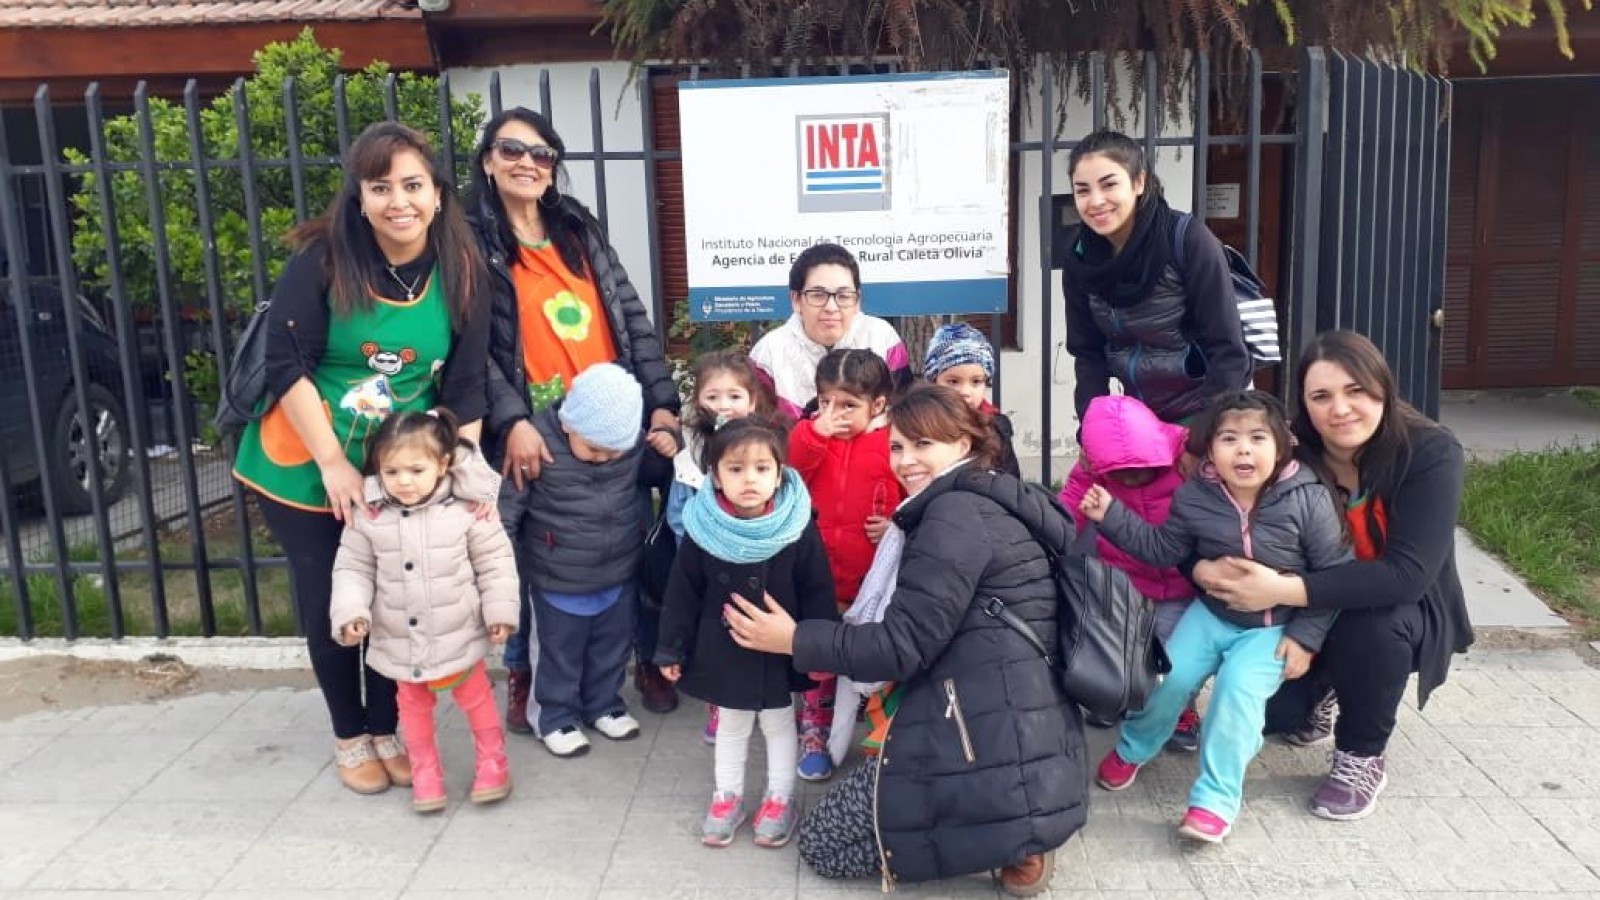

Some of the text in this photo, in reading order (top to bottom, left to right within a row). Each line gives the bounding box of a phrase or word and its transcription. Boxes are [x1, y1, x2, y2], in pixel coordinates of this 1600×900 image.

[805, 122, 880, 169] INTA
[701, 237, 754, 250] Instituto
[757, 235, 812, 249] Nacional
[815, 235, 832, 245] de
[906, 230, 993, 246] Agropecuaria
[711, 254, 765, 269] Agencia
[768, 252, 785, 265] de
[858, 248, 894, 263] Rural
[897, 247, 940, 261] Caleta
[943, 246, 983, 260] Olivia
